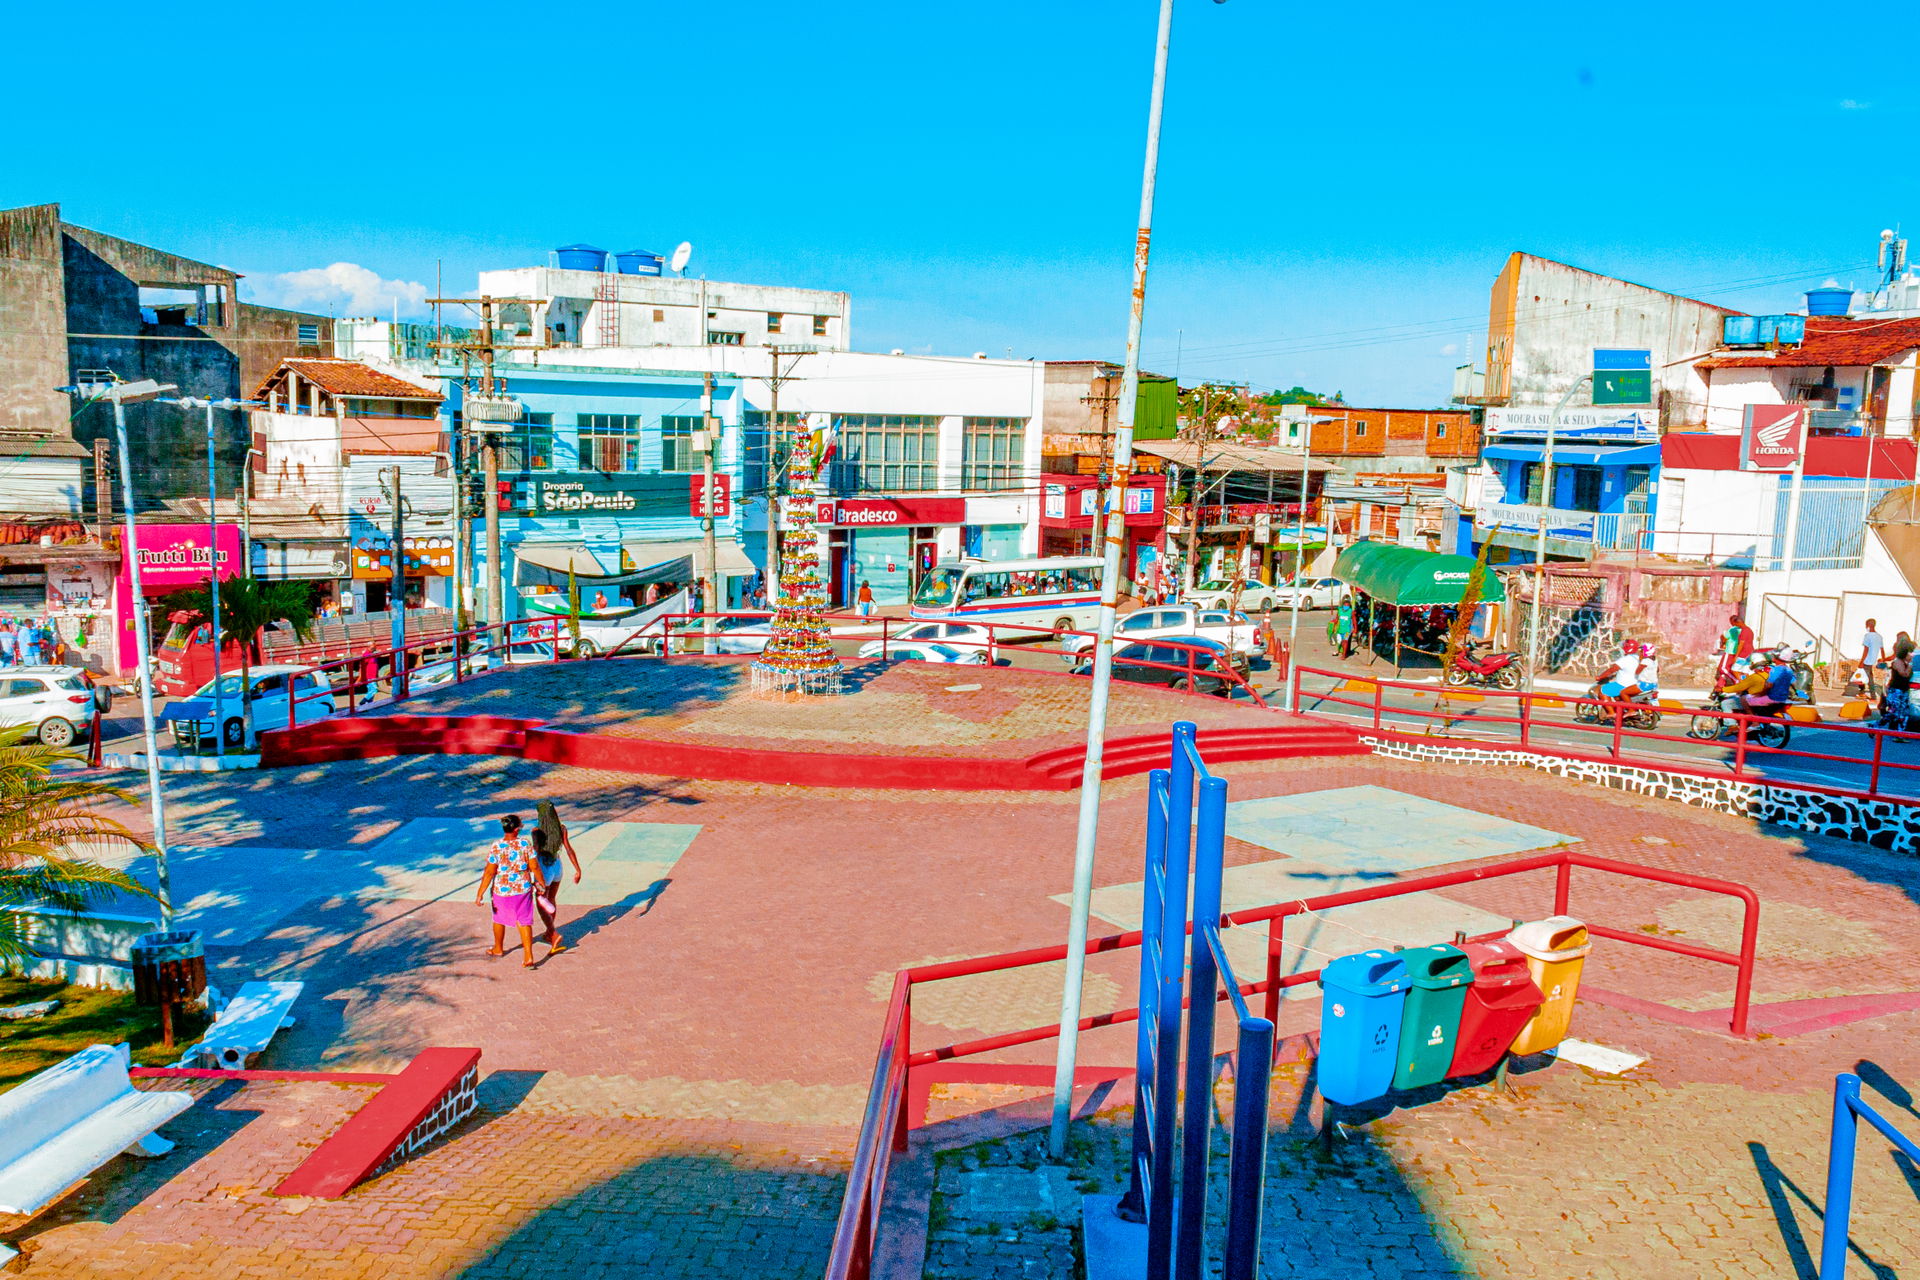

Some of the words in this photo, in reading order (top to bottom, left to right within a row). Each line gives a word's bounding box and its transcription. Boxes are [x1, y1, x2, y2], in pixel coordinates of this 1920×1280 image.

[1507, 414, 1537, 424] MOURA
[1538, 414, 1561, 425] SILA
[1563, 415, 1570, 424] &
[1572, 415, 1597, 425] SILVA
[1755, 447, 1795, 455] HONDA
[543, 481, 584, 492] Drogaria
[837, 508, 897, 523] Bradesco
[1492, 509, 1515, 519] MOURA
[137, 548, 186, 564] Tutti
[192, 547, 228, 566] Biu
